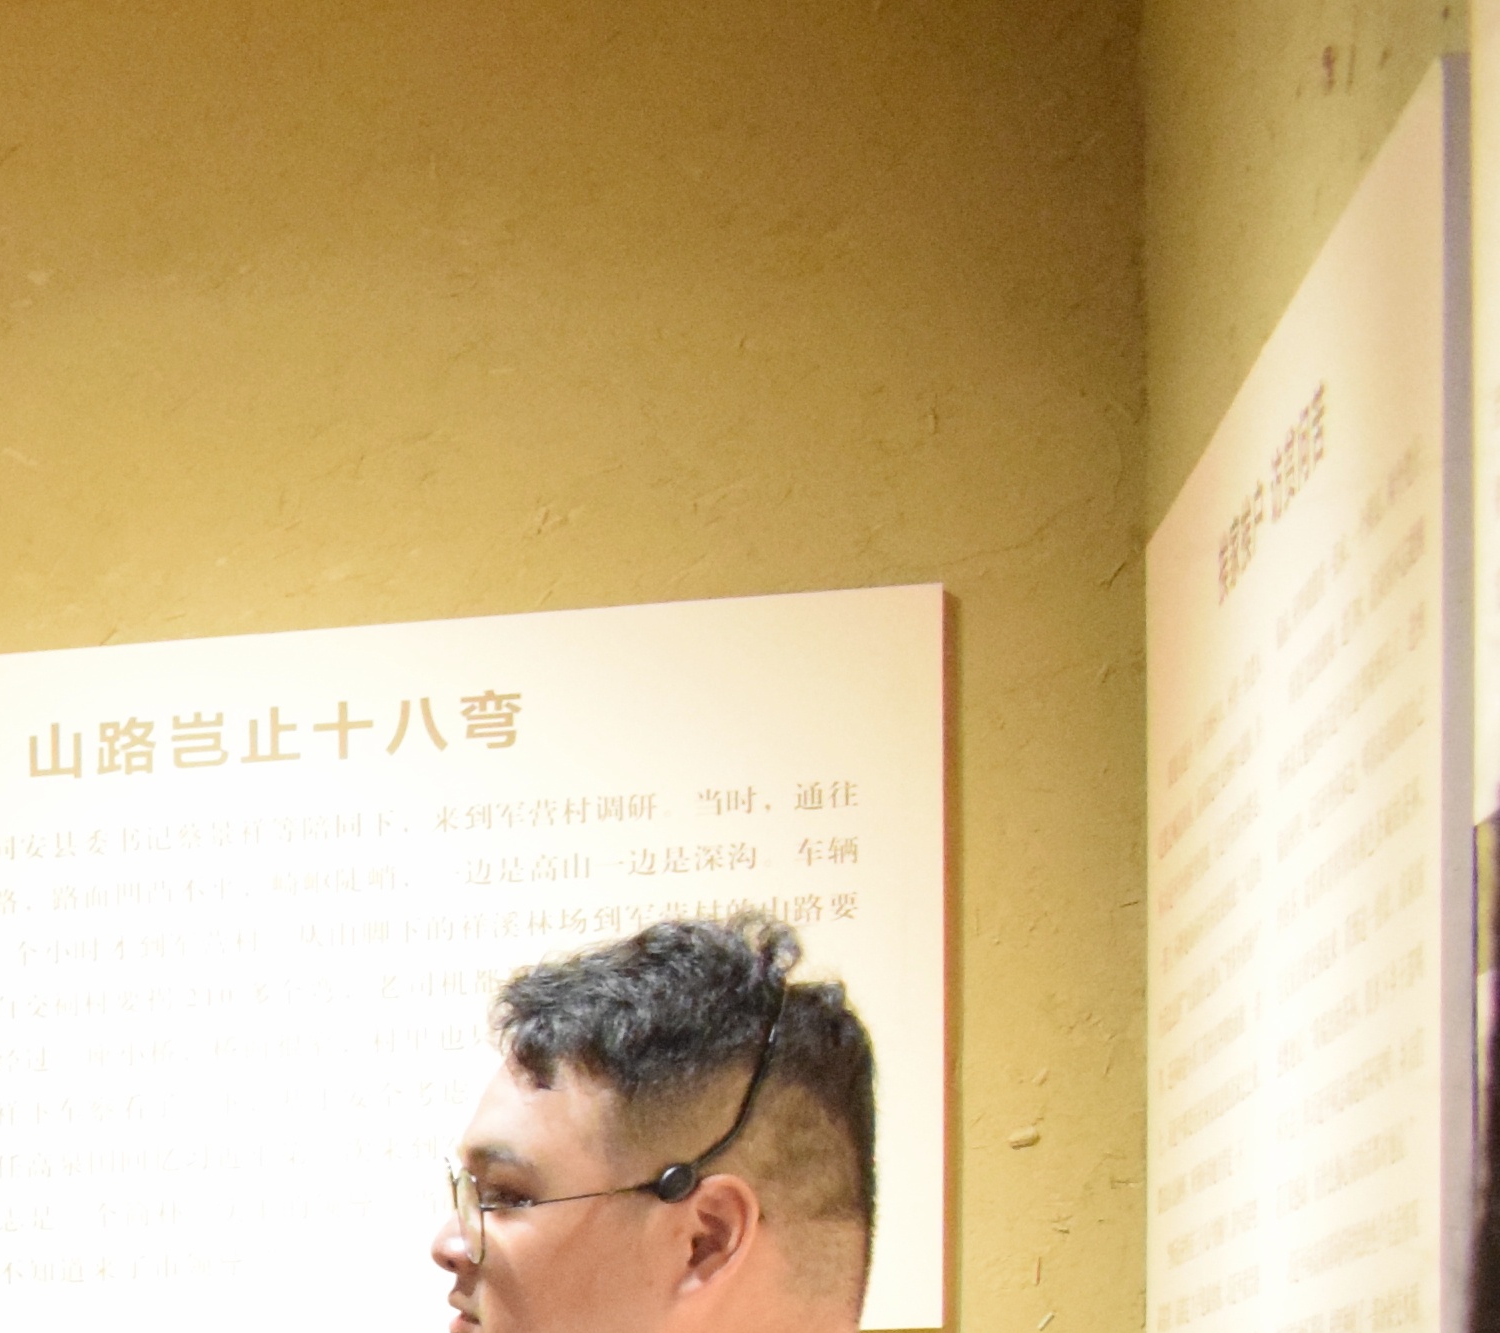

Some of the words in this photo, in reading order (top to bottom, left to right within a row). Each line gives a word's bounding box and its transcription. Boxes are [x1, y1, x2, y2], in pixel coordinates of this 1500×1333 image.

[27, 688, 523, 780] 山路岂止十八弯
